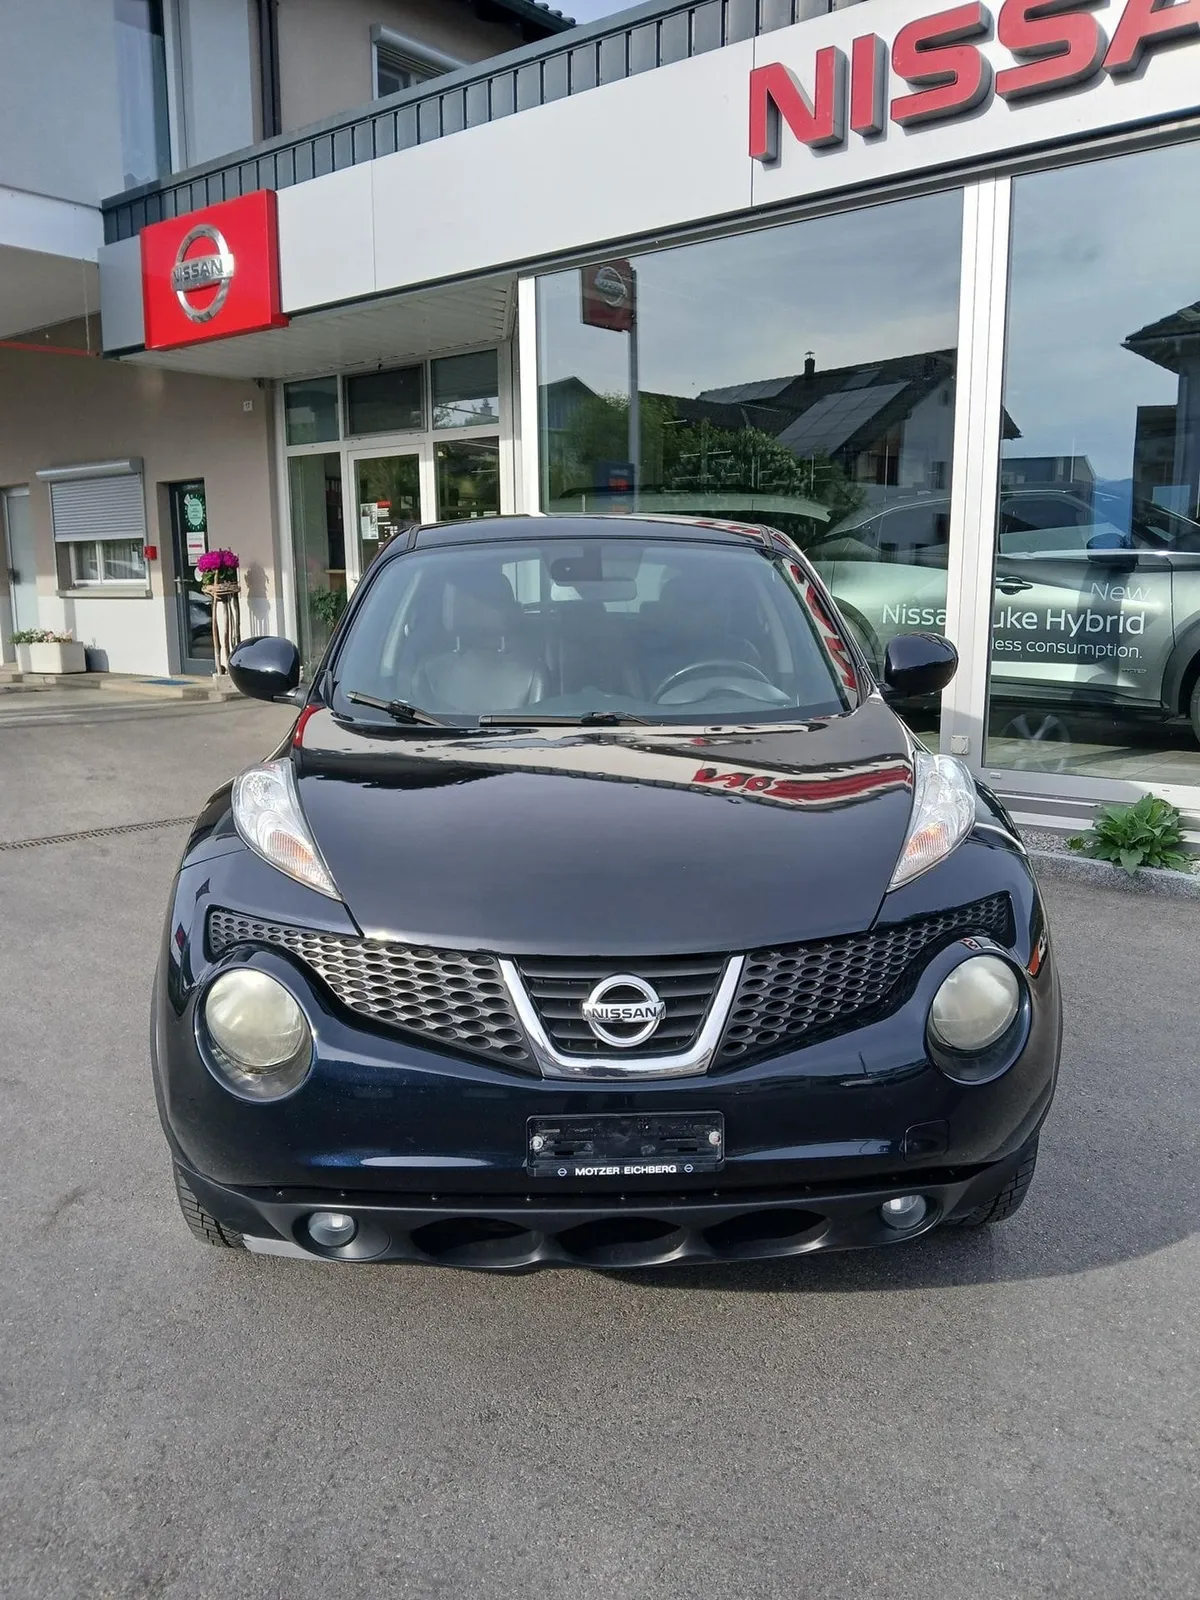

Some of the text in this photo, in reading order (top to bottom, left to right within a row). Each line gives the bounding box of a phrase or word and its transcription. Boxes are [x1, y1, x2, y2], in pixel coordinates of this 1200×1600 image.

[172, 258, 224, 283] NISSAN
[1090, 582, 1151, 602] New
[1046, 608, 1146, 637] Hybrid
[991, 637, 1143, 660] less consumption.
[591, 1006, 657, 1019] NISSAN
[575, 1164, 677, 1176] MOTZER EICHBERG
